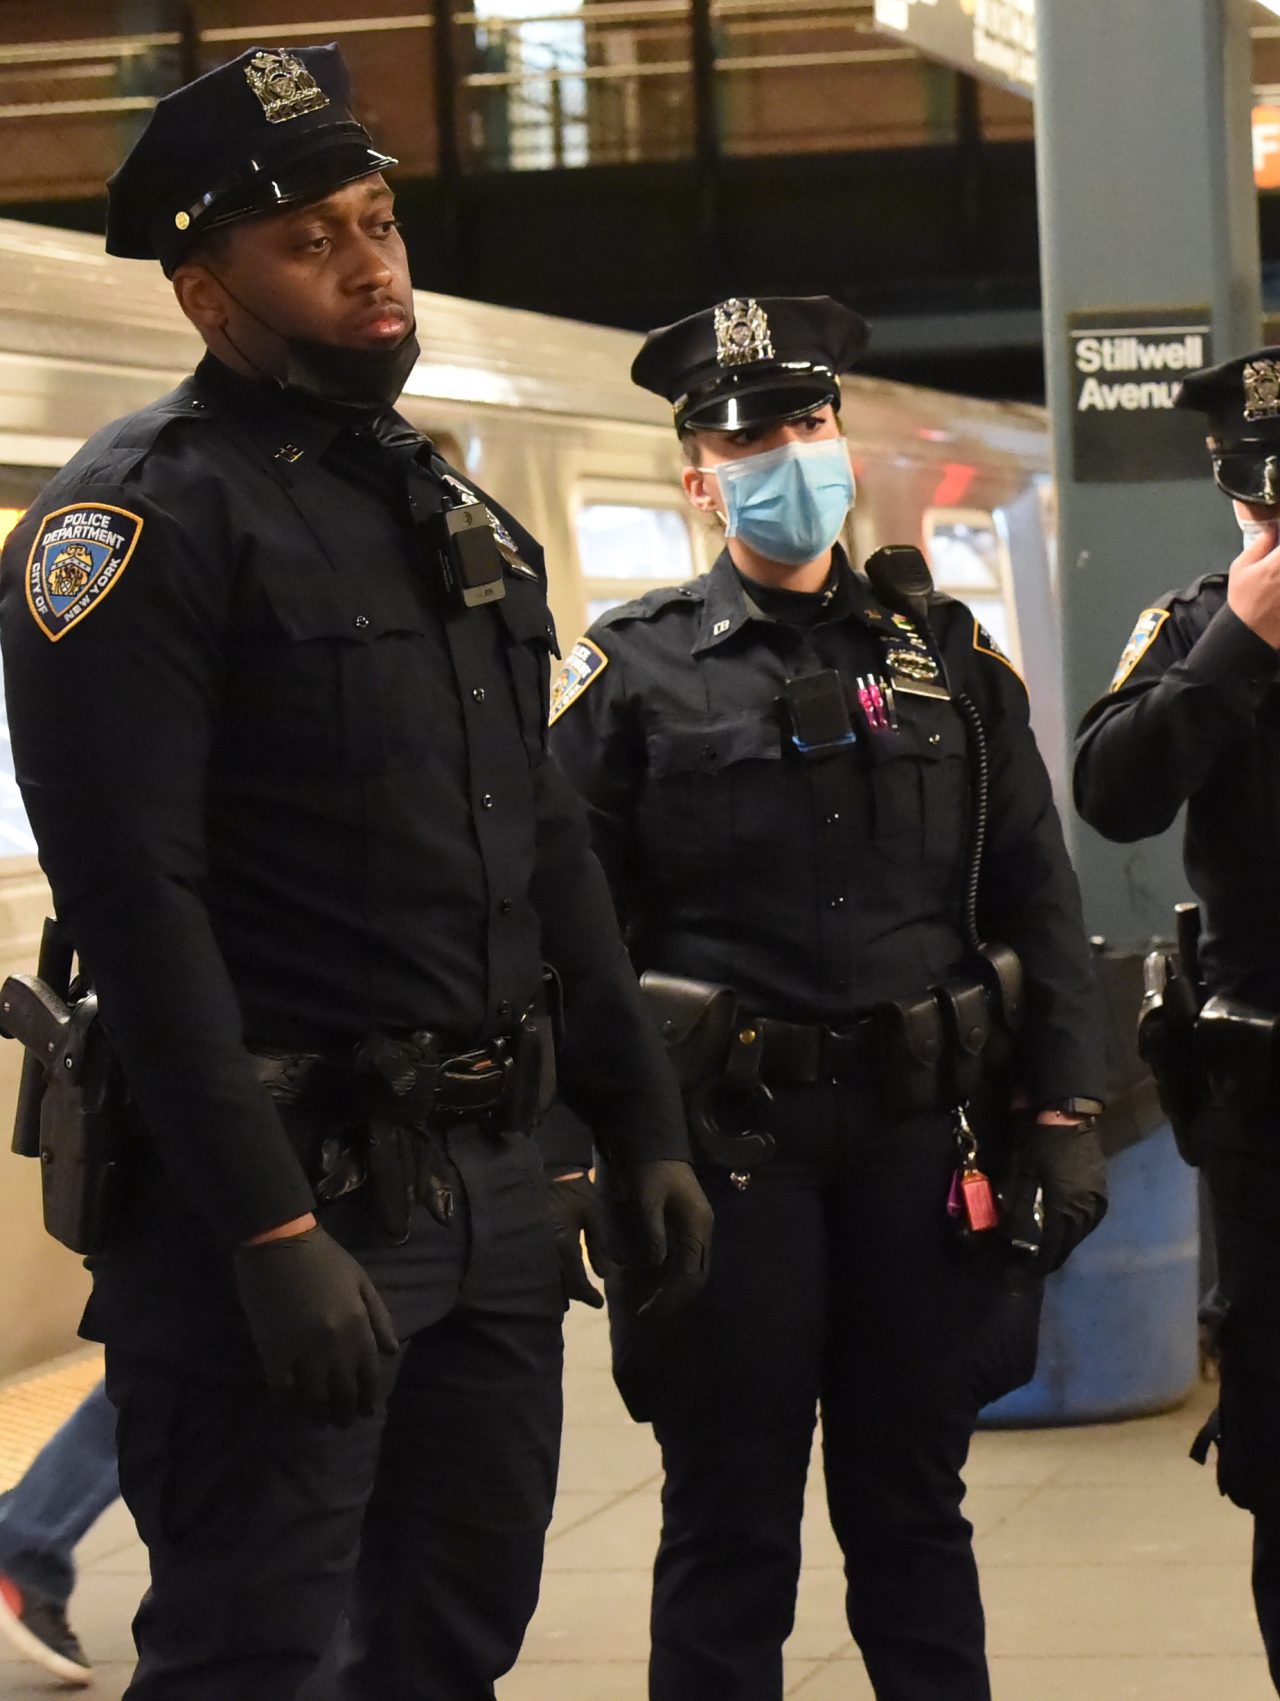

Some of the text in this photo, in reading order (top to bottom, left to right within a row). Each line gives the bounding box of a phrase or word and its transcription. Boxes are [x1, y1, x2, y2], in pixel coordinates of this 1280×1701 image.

[1076, 335, 1204, 374] Stillwell
[1077, 377, 1184, 412] Avenu
[41, 525, 125, 550] DEPARTMENT
[62, 512, 112, 529] POLICE
[31, 557, 122, 622] CITY OF NEW YORK
